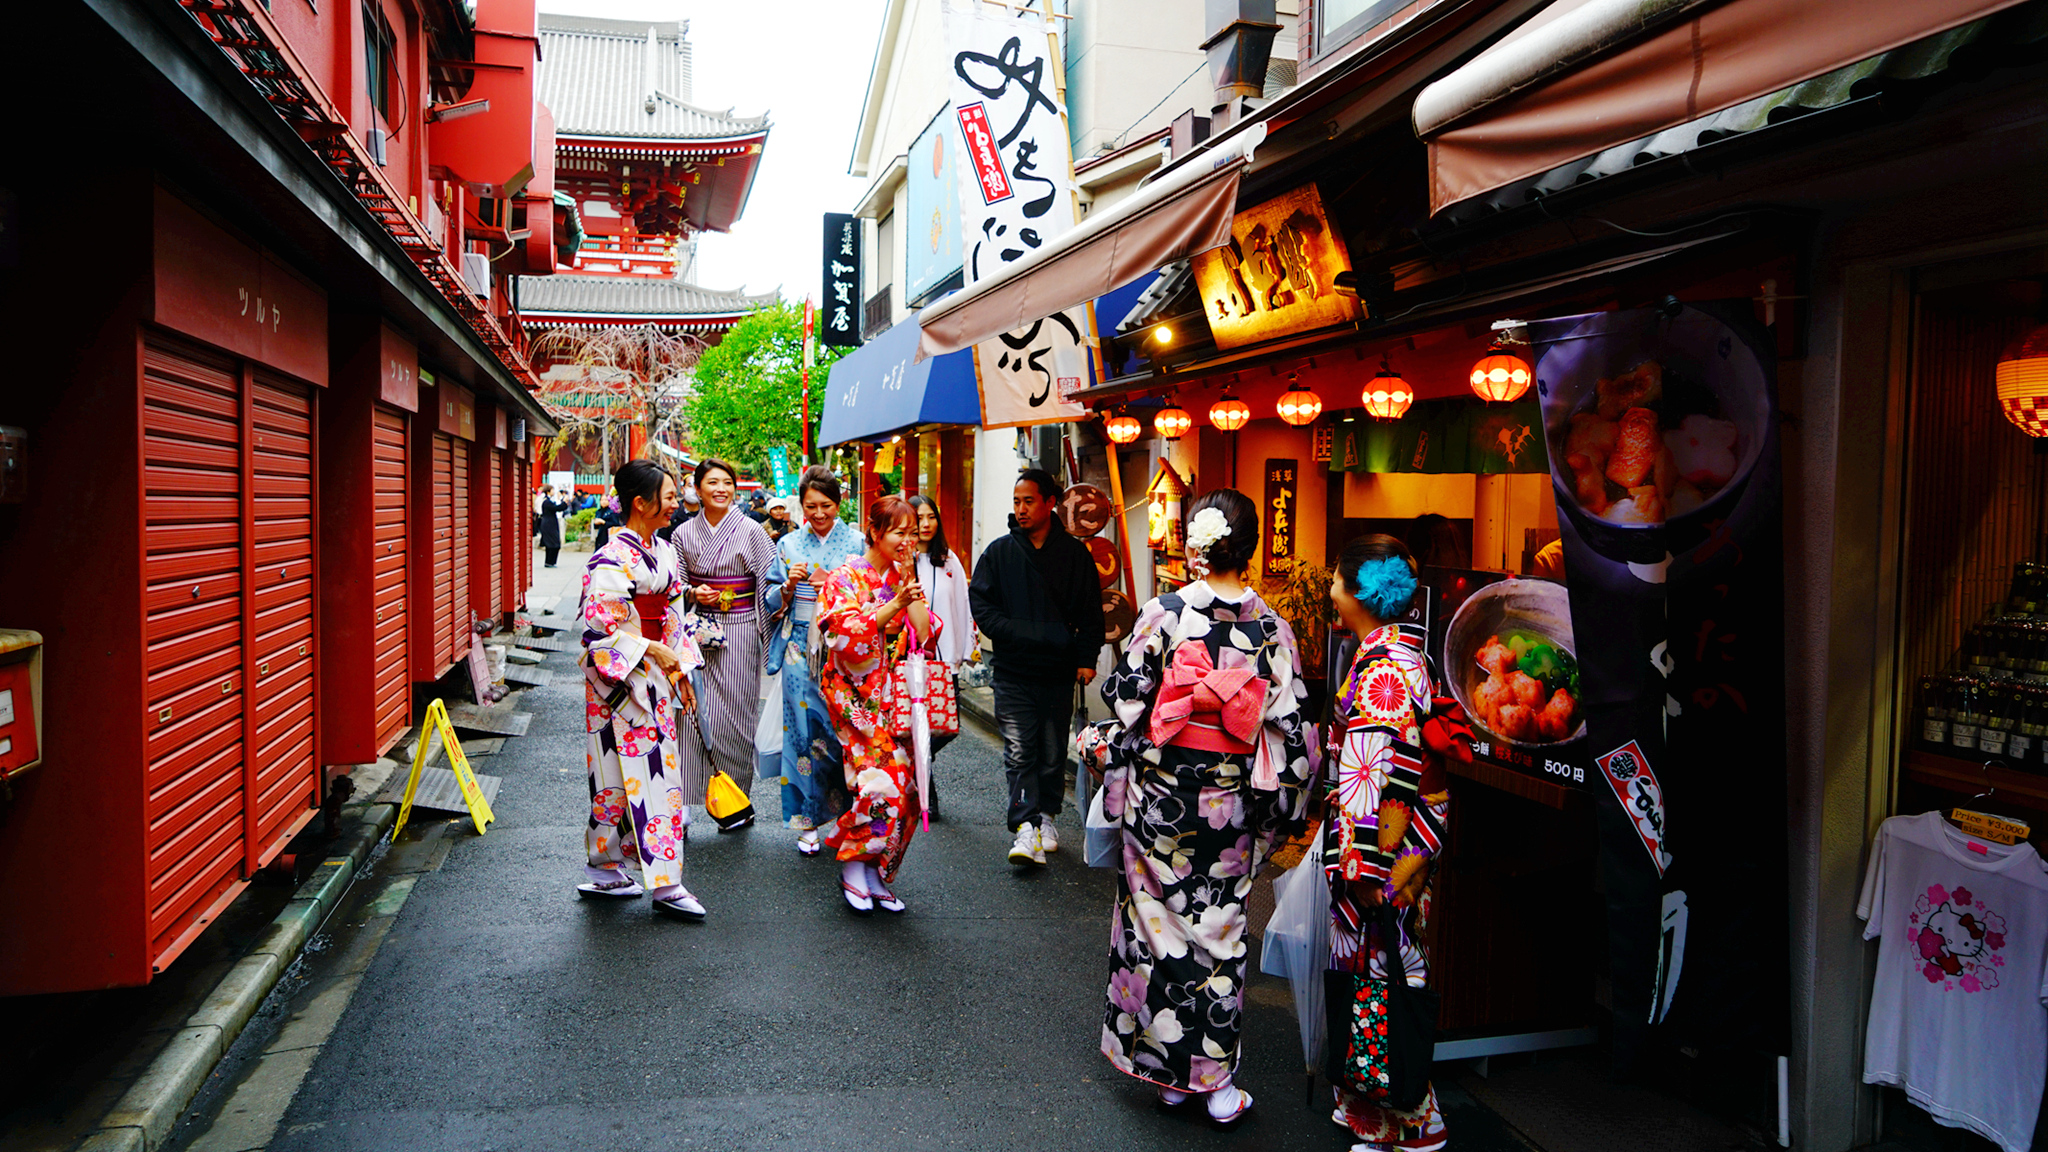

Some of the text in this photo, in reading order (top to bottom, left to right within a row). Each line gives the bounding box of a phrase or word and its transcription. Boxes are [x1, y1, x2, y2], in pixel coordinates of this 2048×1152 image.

[238, 286, 281, 334] ツルヤ
[830, 259, 855, 333] 加賀屋
[1271, 468, 1293, 482] 浅草
[1272, 486, 1293, 556] よ兵衛
[1954, 809, 1982, 824] Price
[1962, 824, 2011, 843] size S/M
